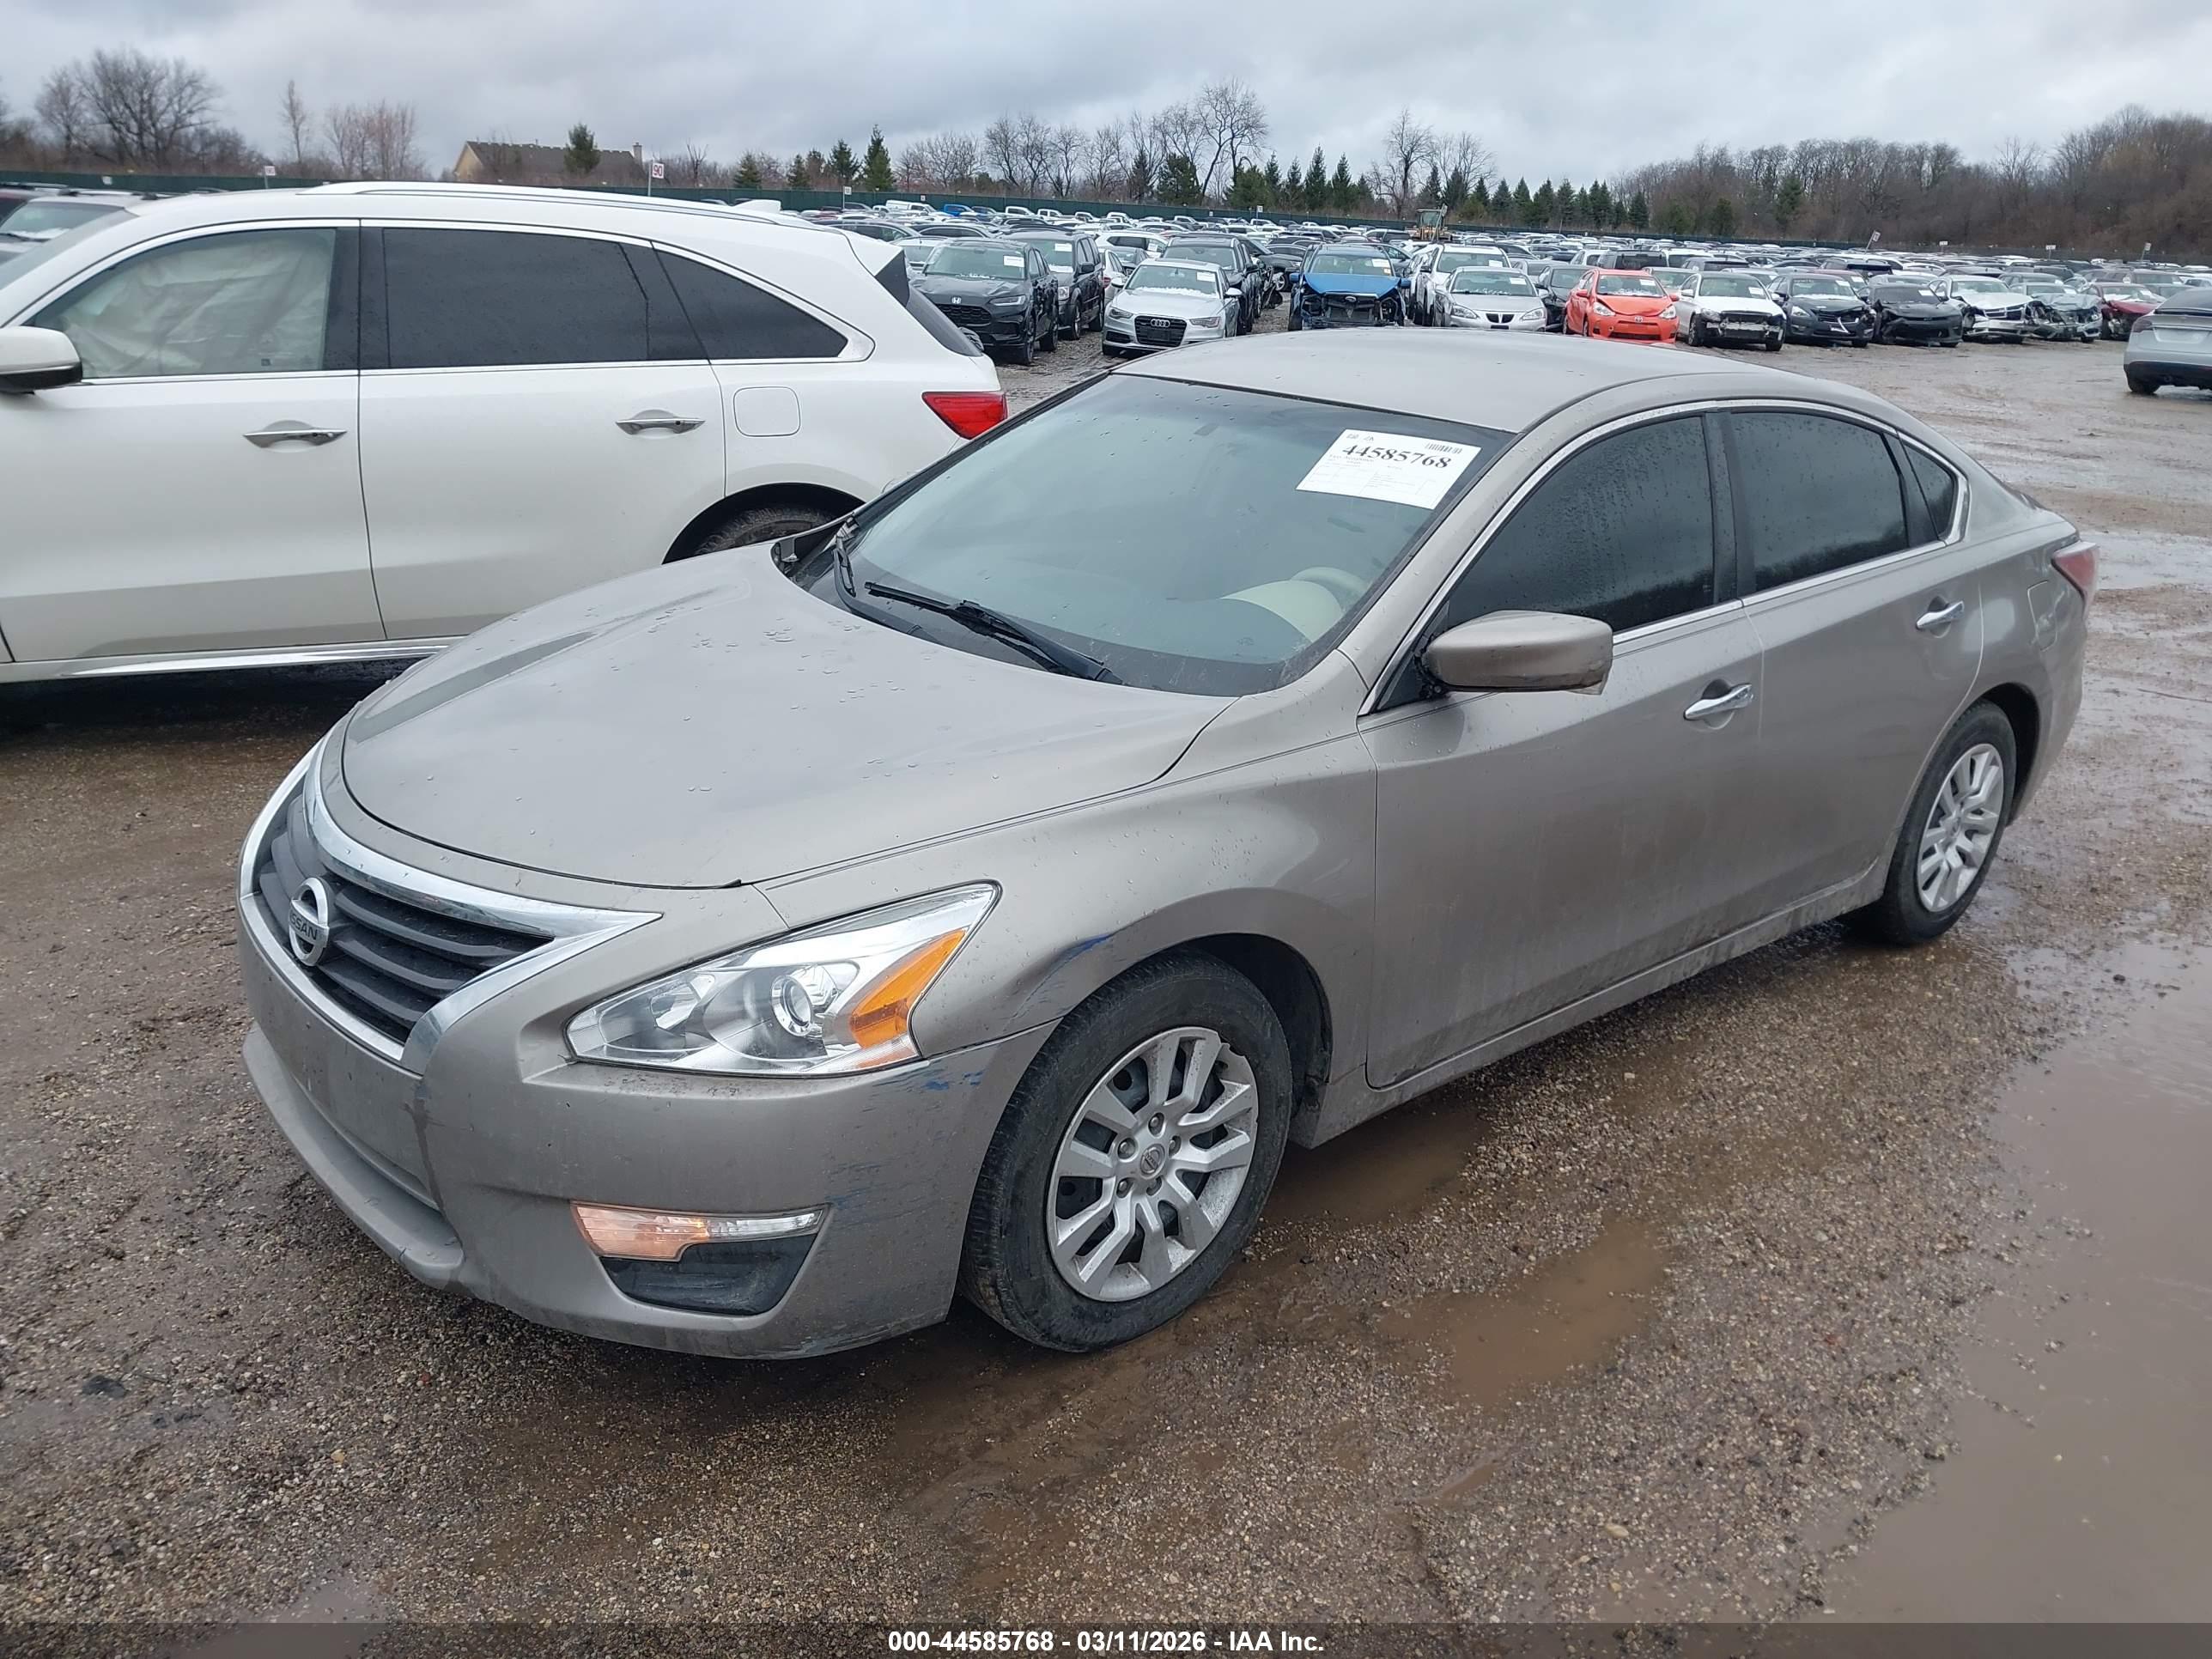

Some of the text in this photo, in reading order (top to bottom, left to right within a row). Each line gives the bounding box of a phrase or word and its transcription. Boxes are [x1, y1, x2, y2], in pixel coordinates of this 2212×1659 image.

[653, 164, 663, 177] 90
[1342, 444, 1452, 469] 44585768
[289, 910, 318, 940] ISSAN
